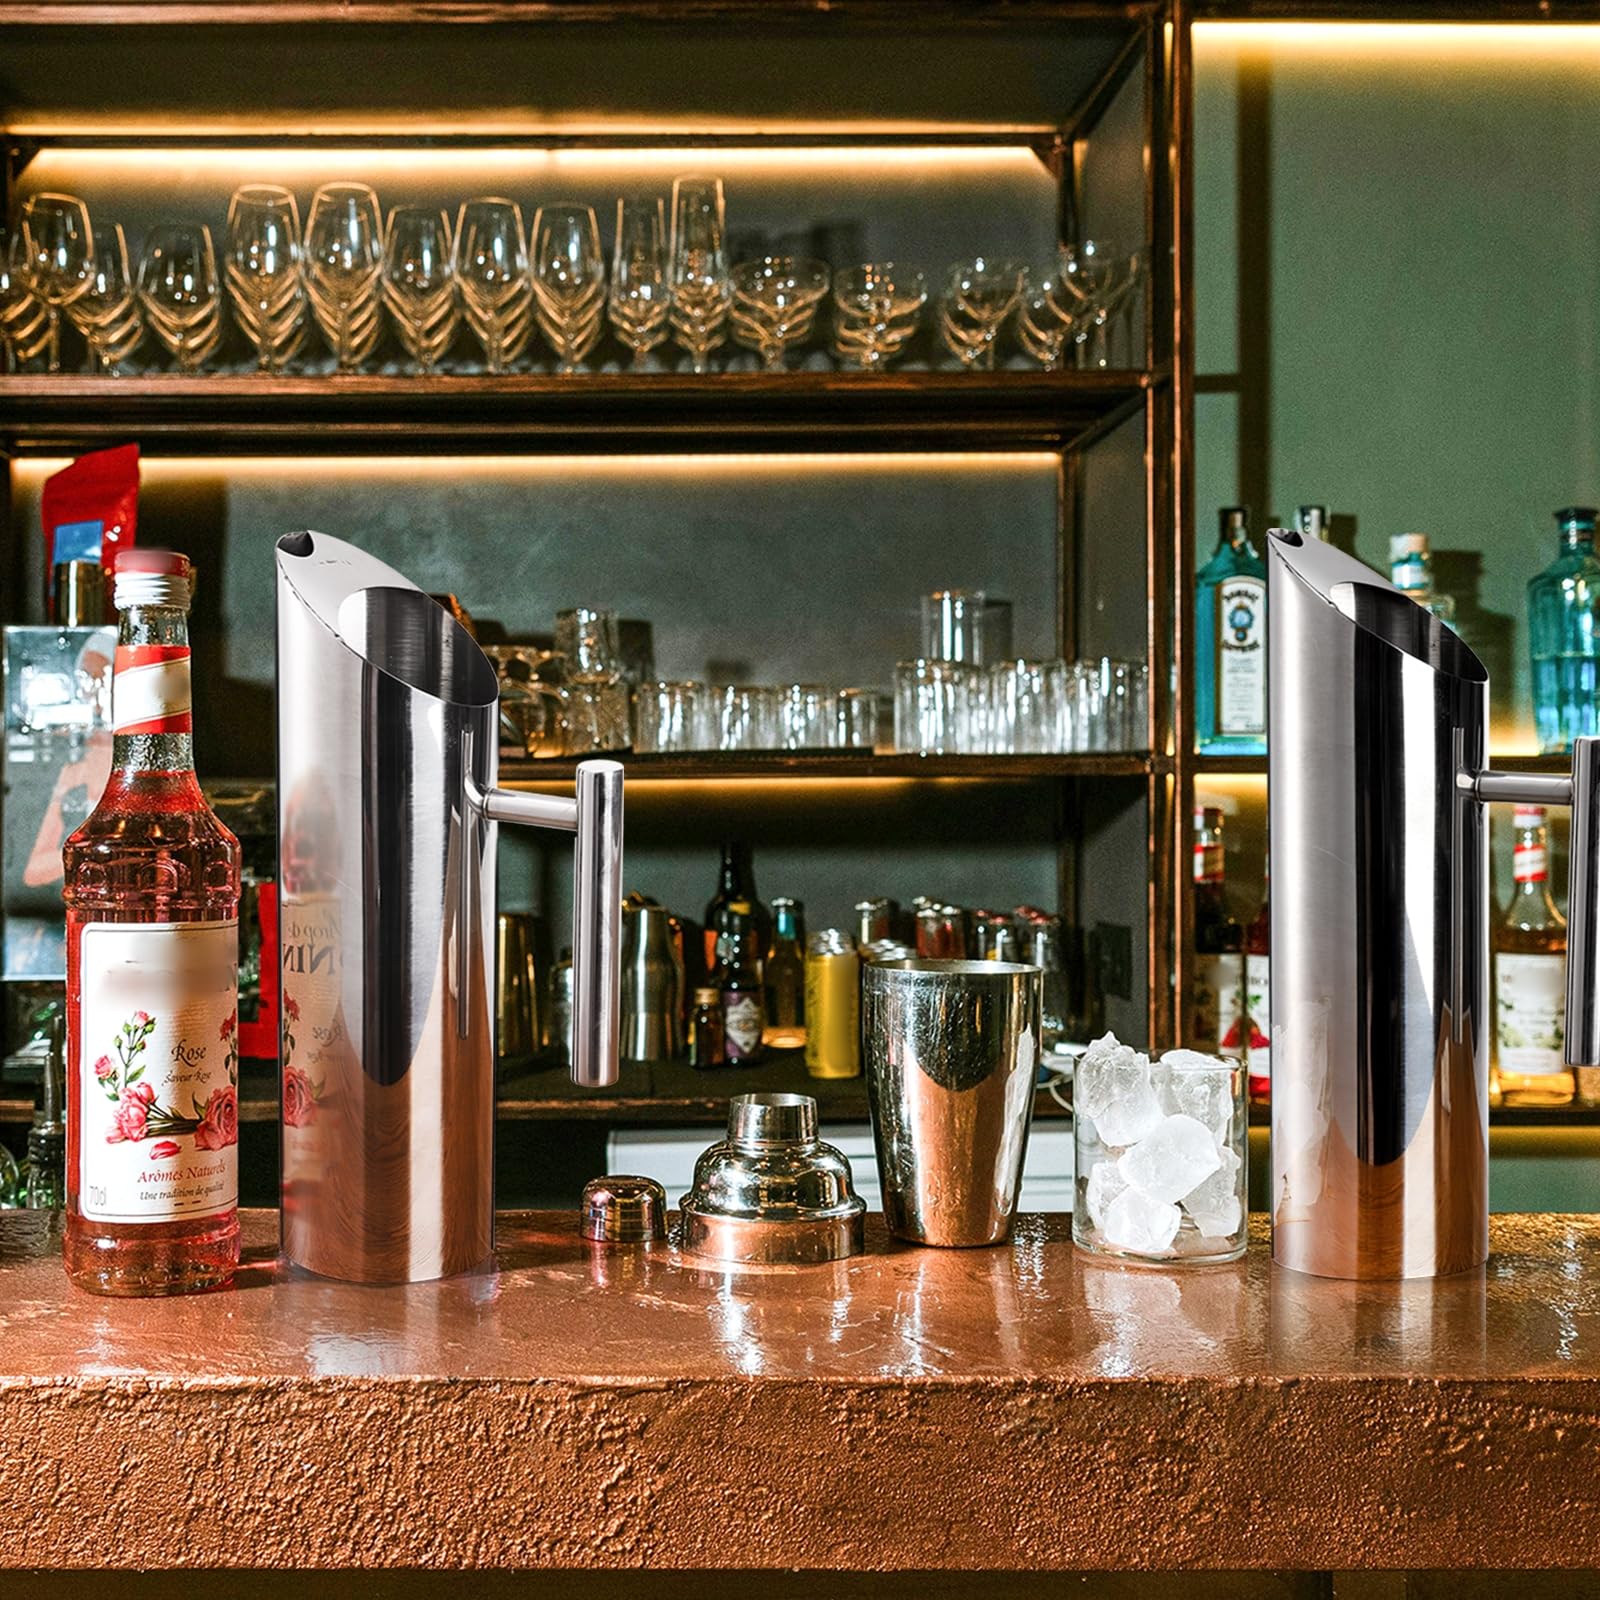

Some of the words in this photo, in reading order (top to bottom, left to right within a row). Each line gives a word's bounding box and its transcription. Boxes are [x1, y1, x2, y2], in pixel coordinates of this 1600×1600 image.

[171, 1039, 206, 1067] Rose
[137, 1169, 183, 1183] Arômes
[187, 1159, 226, 1179] Naturels
[89, 1185, 107, 1206] 70cl
[140, 1191, 157, 1201] Une
[159, 1186, 194, 1200] tradition
[195, 1184, 204, 1197] de
